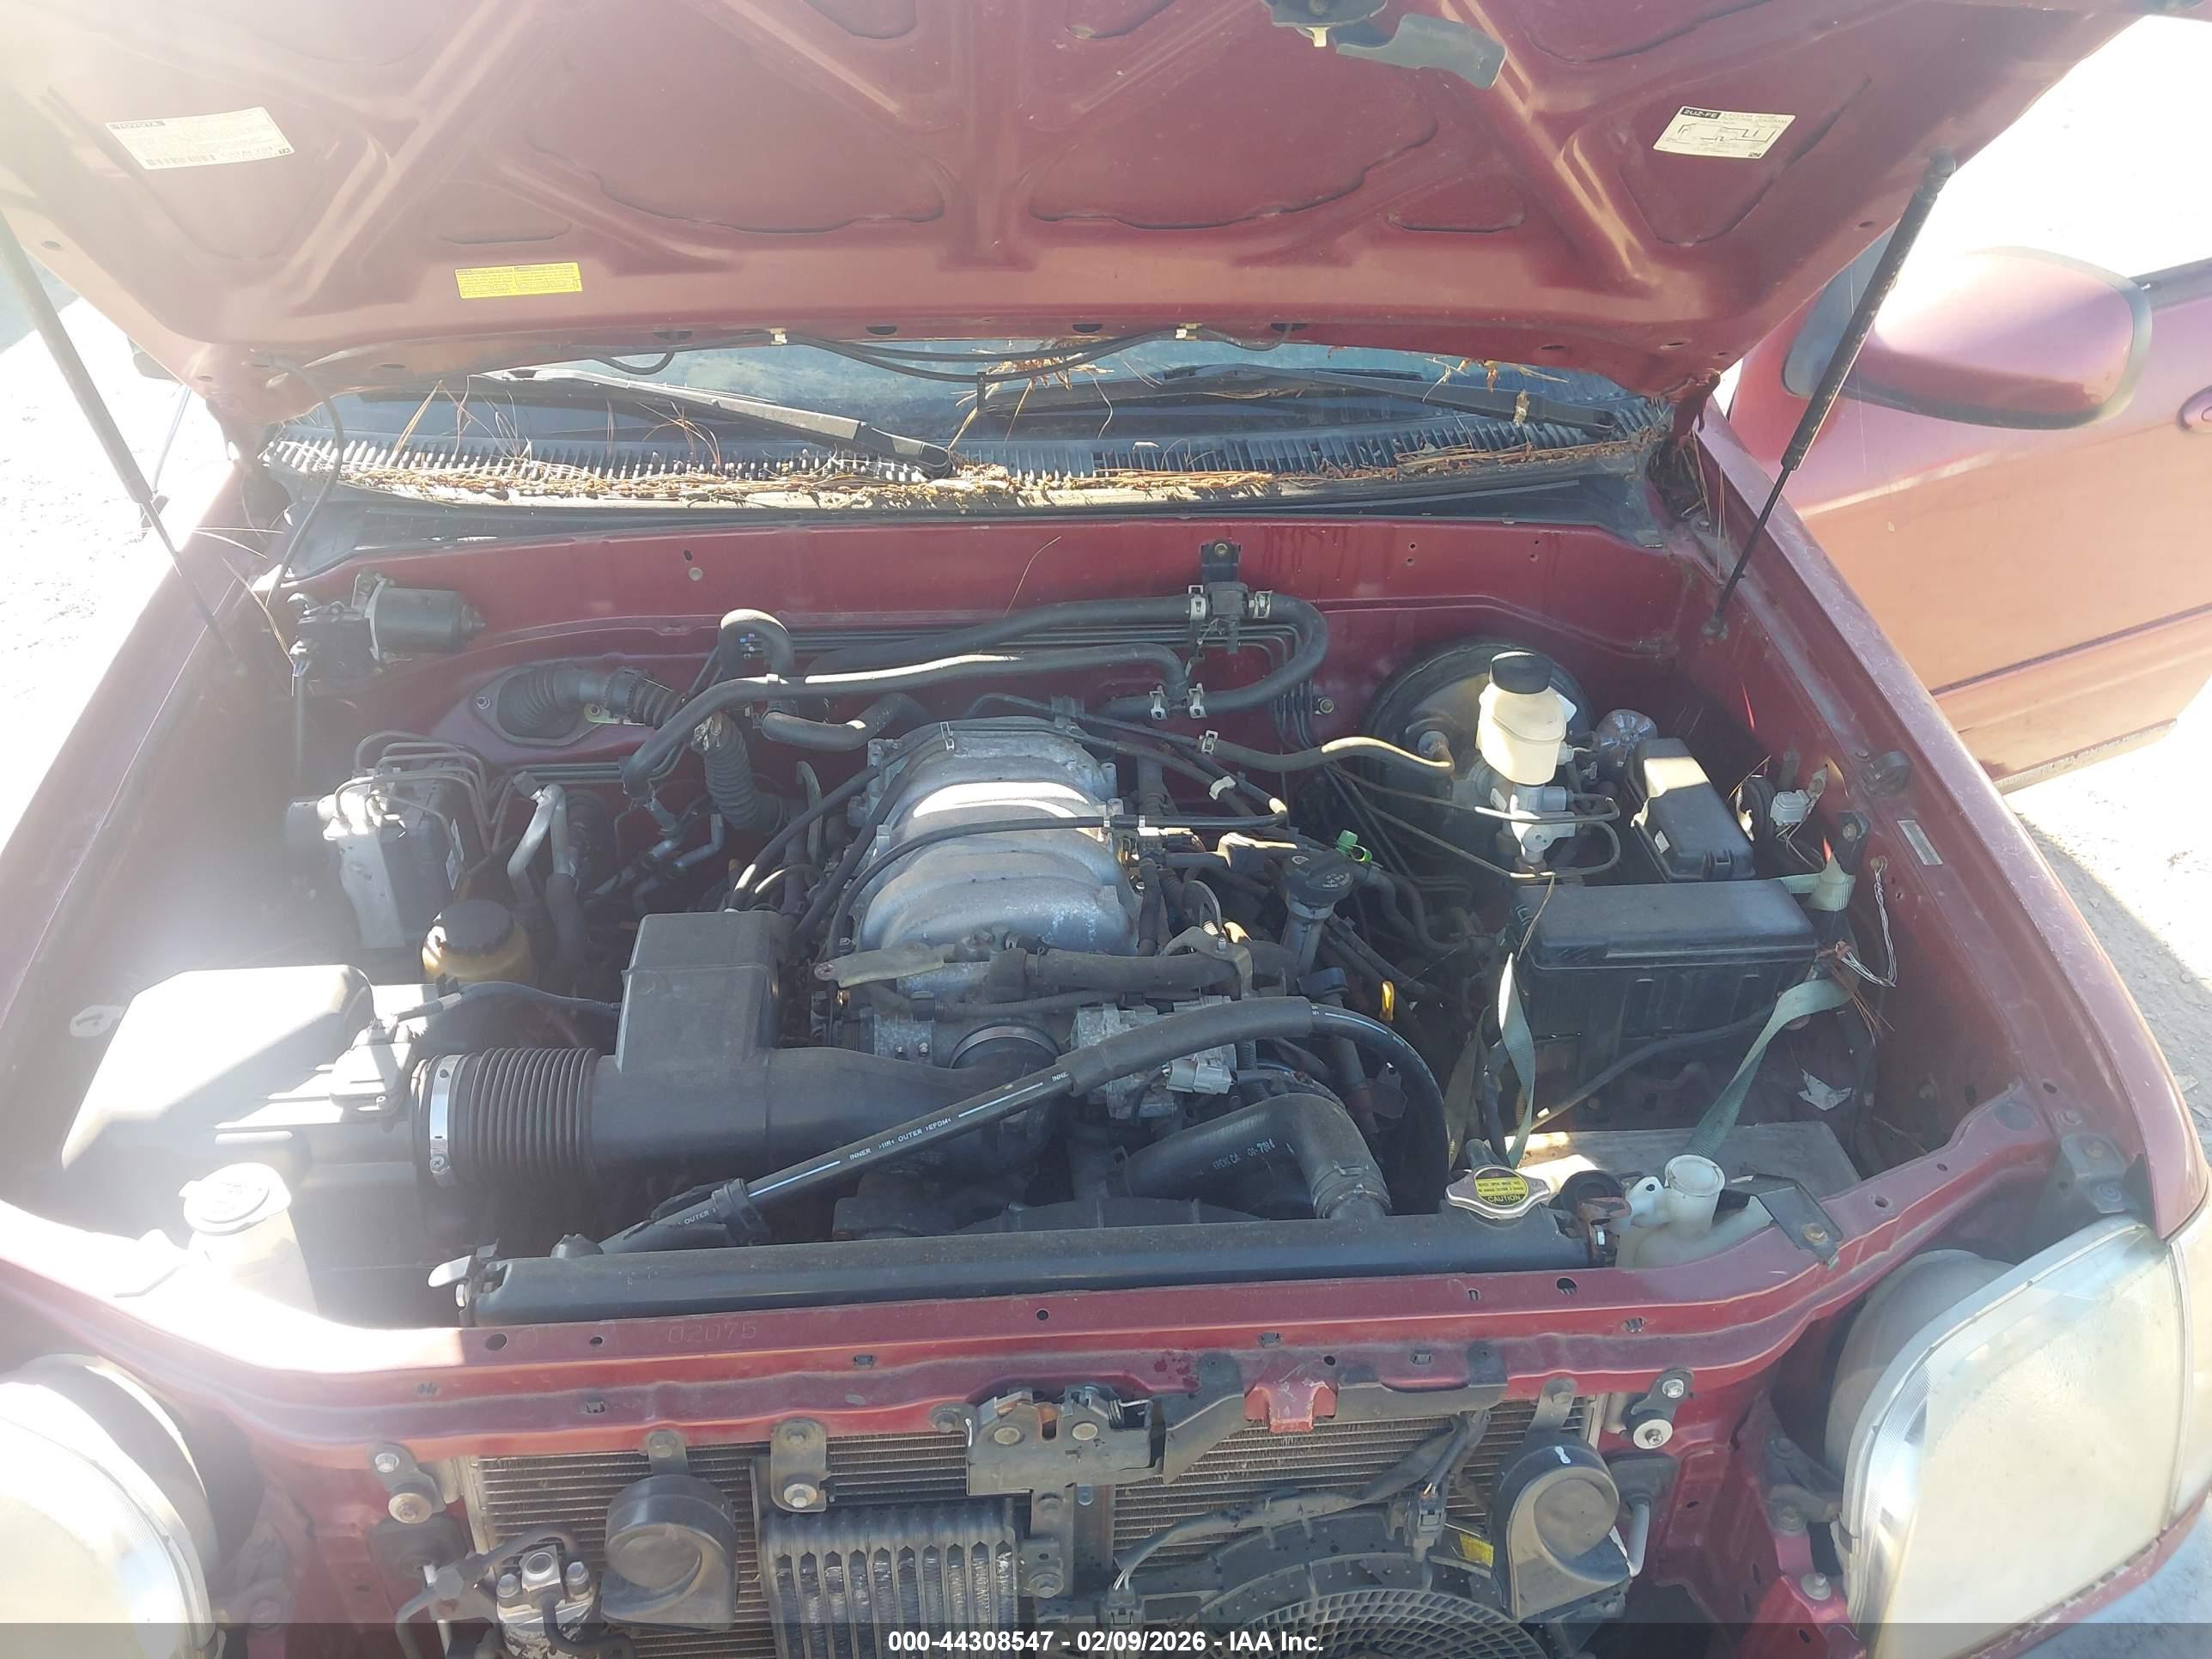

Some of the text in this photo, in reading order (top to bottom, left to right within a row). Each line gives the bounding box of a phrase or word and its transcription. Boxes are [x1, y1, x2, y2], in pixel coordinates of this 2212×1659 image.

[1683, 109, 1718, 118] 2UZ-FE
[849, 1147, 872, 1160] INNER
[897, 1128, 922, 1142] OUTER
[1487, 1194, 1521, 1203] CAUTION
[684, 1210, 709, 1224] OUTER
